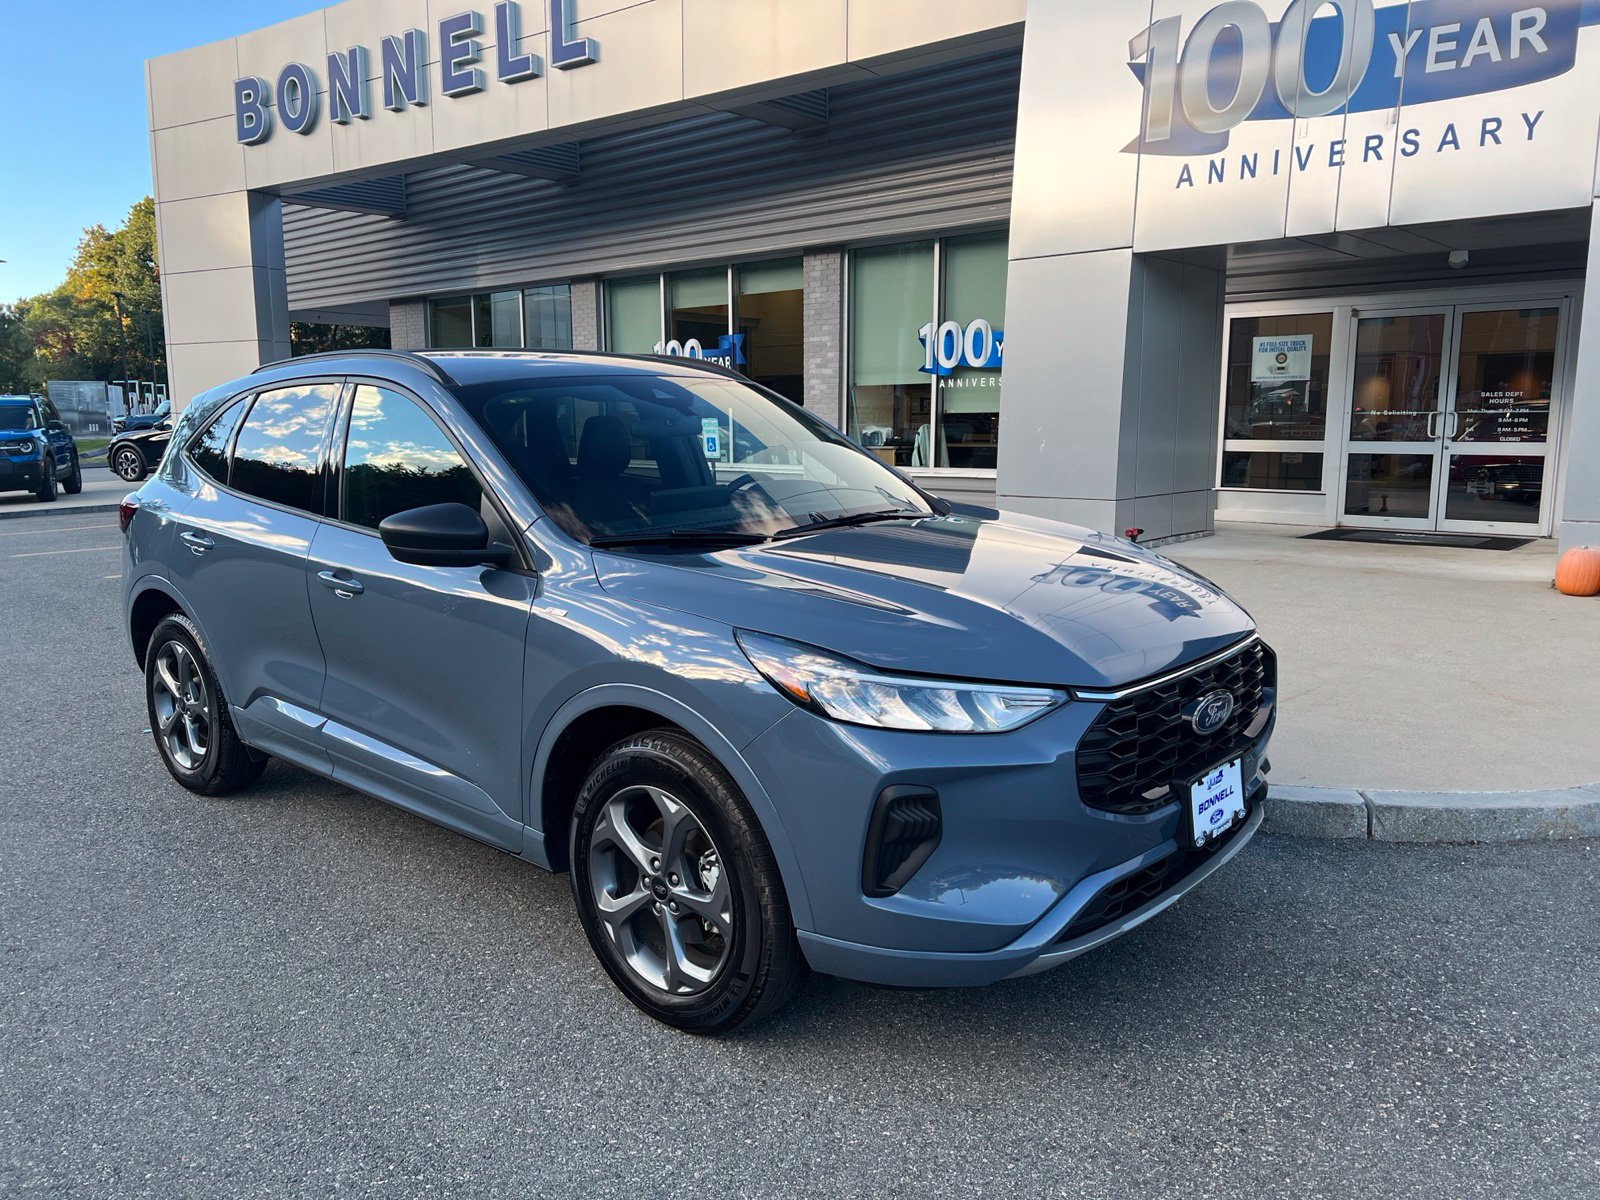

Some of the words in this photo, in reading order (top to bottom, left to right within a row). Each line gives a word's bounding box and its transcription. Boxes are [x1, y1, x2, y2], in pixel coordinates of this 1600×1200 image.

[234, 0, 597, 145] BONNELL
[1127, 0, 1375, 143] 100
[1387, 7, 1549, 78] YEAR
[1176, 110, 1544, 188] ANNIVERSARY
[918, 318, 993, 369] 100
[586, 759, 629, 796] MICHELIN
[1198, 785, 1235, 815] BONNELL
